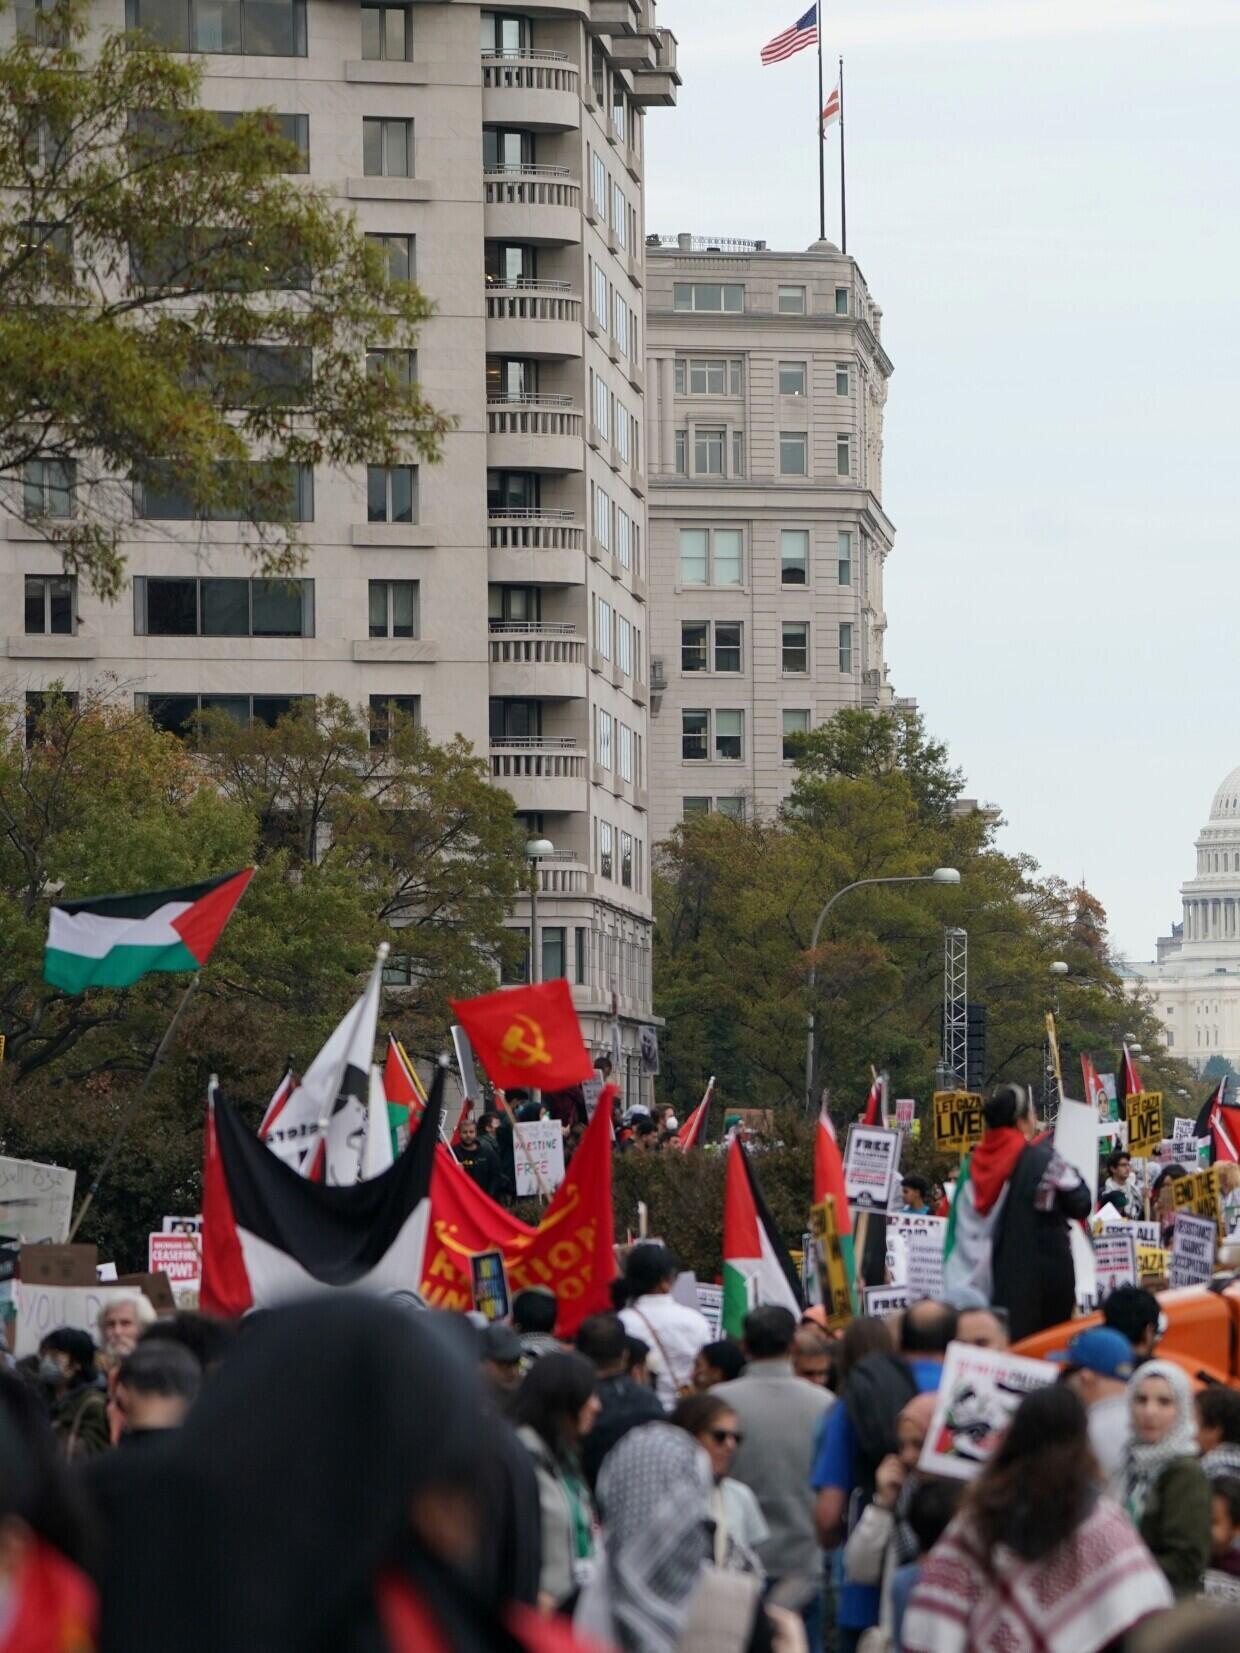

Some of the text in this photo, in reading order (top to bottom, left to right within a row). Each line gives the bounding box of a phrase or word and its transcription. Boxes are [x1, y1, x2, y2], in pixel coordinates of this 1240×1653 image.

[936, 1100, 953, 1115] LET
[856, 1138, 891, 1153] FREE
[1136, 1227, 1156, 1241] ALL
[873, 1298, 906, 1309] FREE
